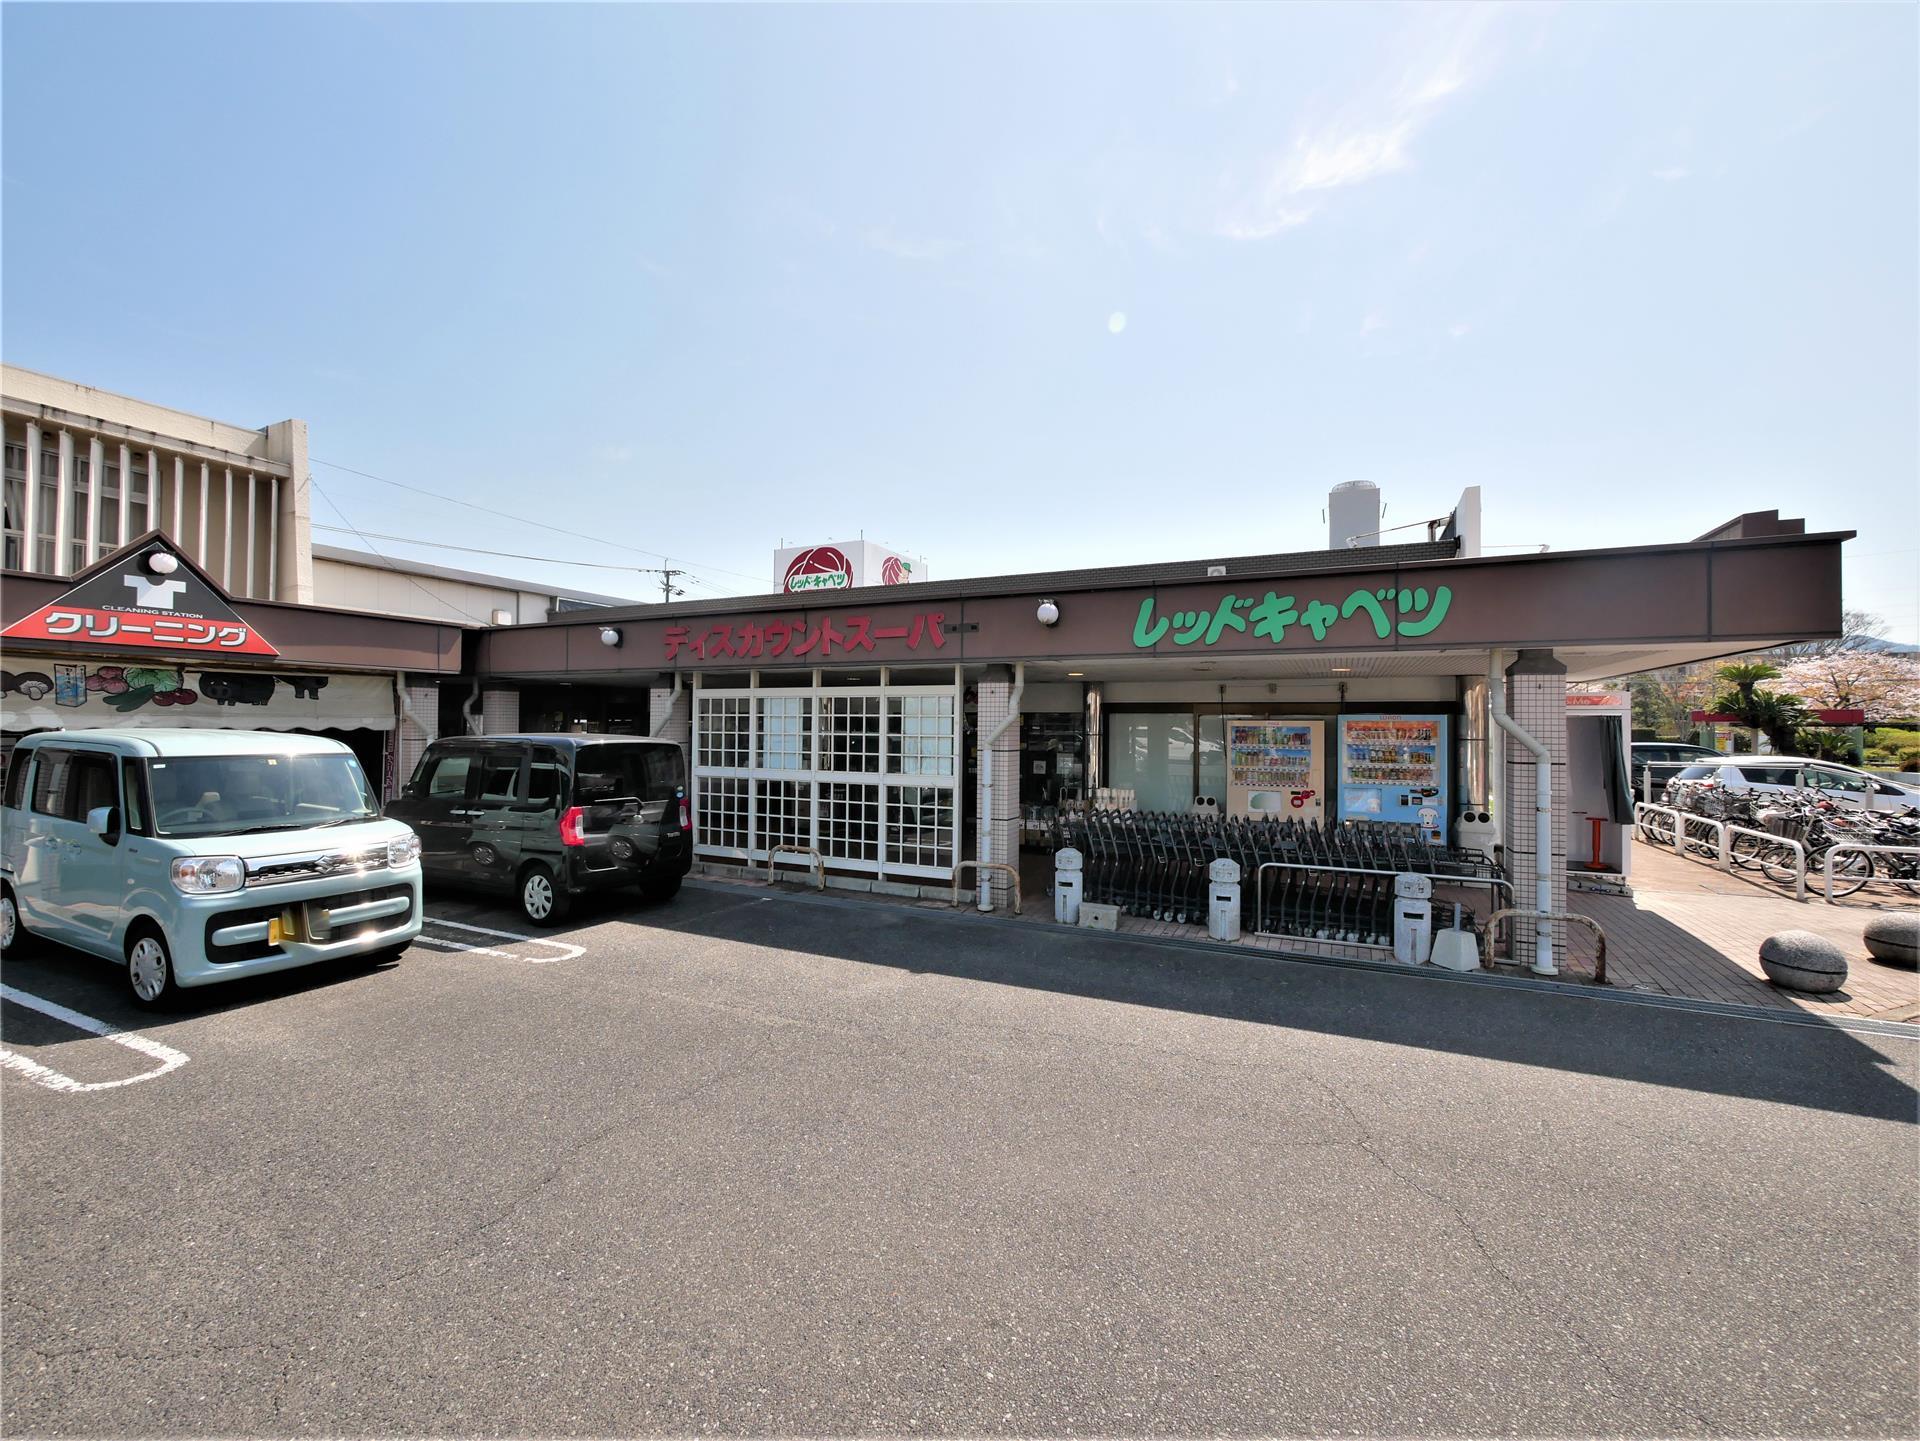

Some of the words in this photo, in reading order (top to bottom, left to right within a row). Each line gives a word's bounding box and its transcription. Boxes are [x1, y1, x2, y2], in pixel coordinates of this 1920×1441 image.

[45, 612, 246, 646] クリーニング
[102, 605, 159, 615] CLEANING
[161, 610, 203, 618] STATION
[1132, 586, 1452, 648] レッドキャベツ
[663, 612, 946, 661] ディスカウントスーパ
